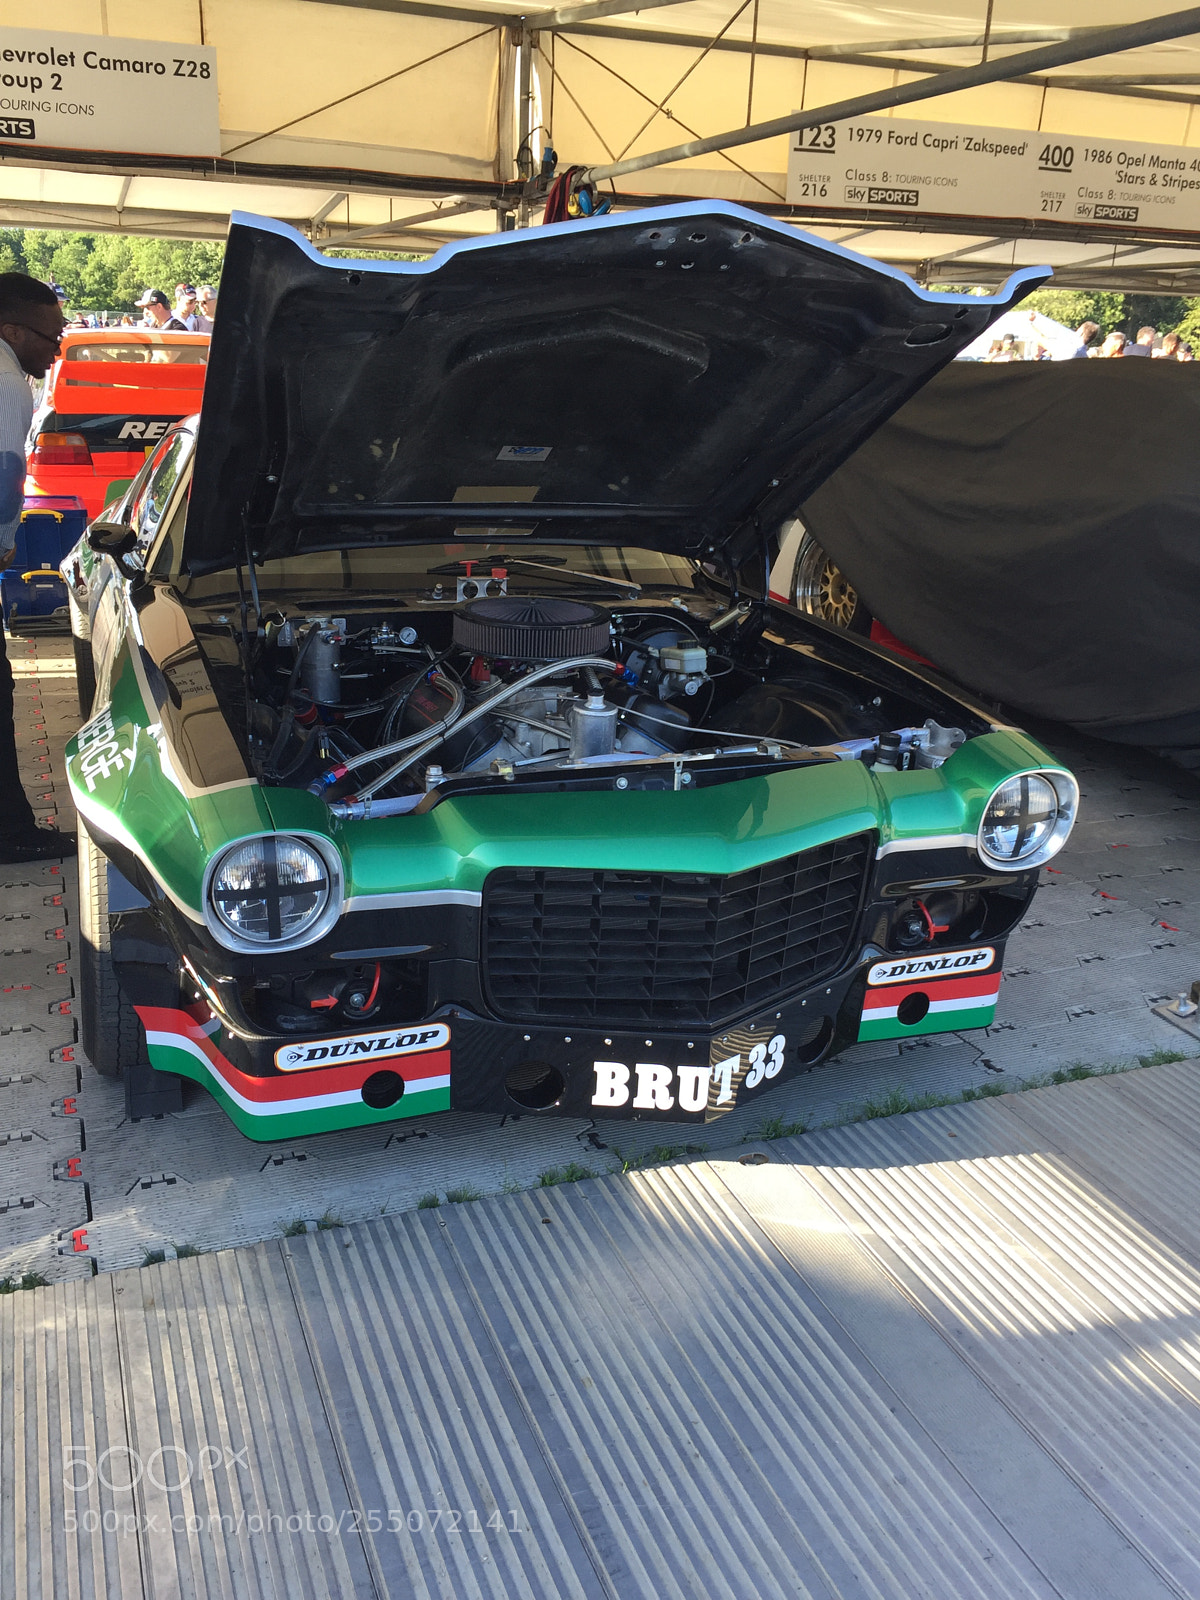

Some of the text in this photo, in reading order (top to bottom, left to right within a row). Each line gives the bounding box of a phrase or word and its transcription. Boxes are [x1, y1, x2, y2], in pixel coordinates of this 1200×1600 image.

[0, 47, 211, 79] evrolet Camaro Z28
[0, 73, 63, 93] oup 2
[0, 98, 95, 116] OURING ICONS
[797, 124, 837, 149] 123
[848, 127, 1028, 157] 1979 Ford Capri 'Zakspeed'
[1038, 144, 1074, 168] 400
[1084, 148, 1113, 164] 1986
[1116, 152, 1146, 169] Opel
[1148, 155, 1186, 171] Manta
[799, 173, 831, 183] SHELTER
[845, 169, 959, 187] Class 8: TOURING ICONS
[1115, 170, 1146, 186] 'Stars
[1149, 174, 1158, 186] &
[801, 183, 828, 198] 216
[847, 187, 917, 204] sky SPORTS
[1040, 190, 1066, 200] SHELTER
[1077, 186, 1176, 205] Class 8: TOURING ICONS
[1041, 199, 1063, 213] 217
[1077, 204, 1137, 220] sky SPORTS
[886, 952, 988, 978] DUNLOP
[303, 1029, 440, 1062] DUNLOP
[591, 1034, 786, 1112] BRUT 33
